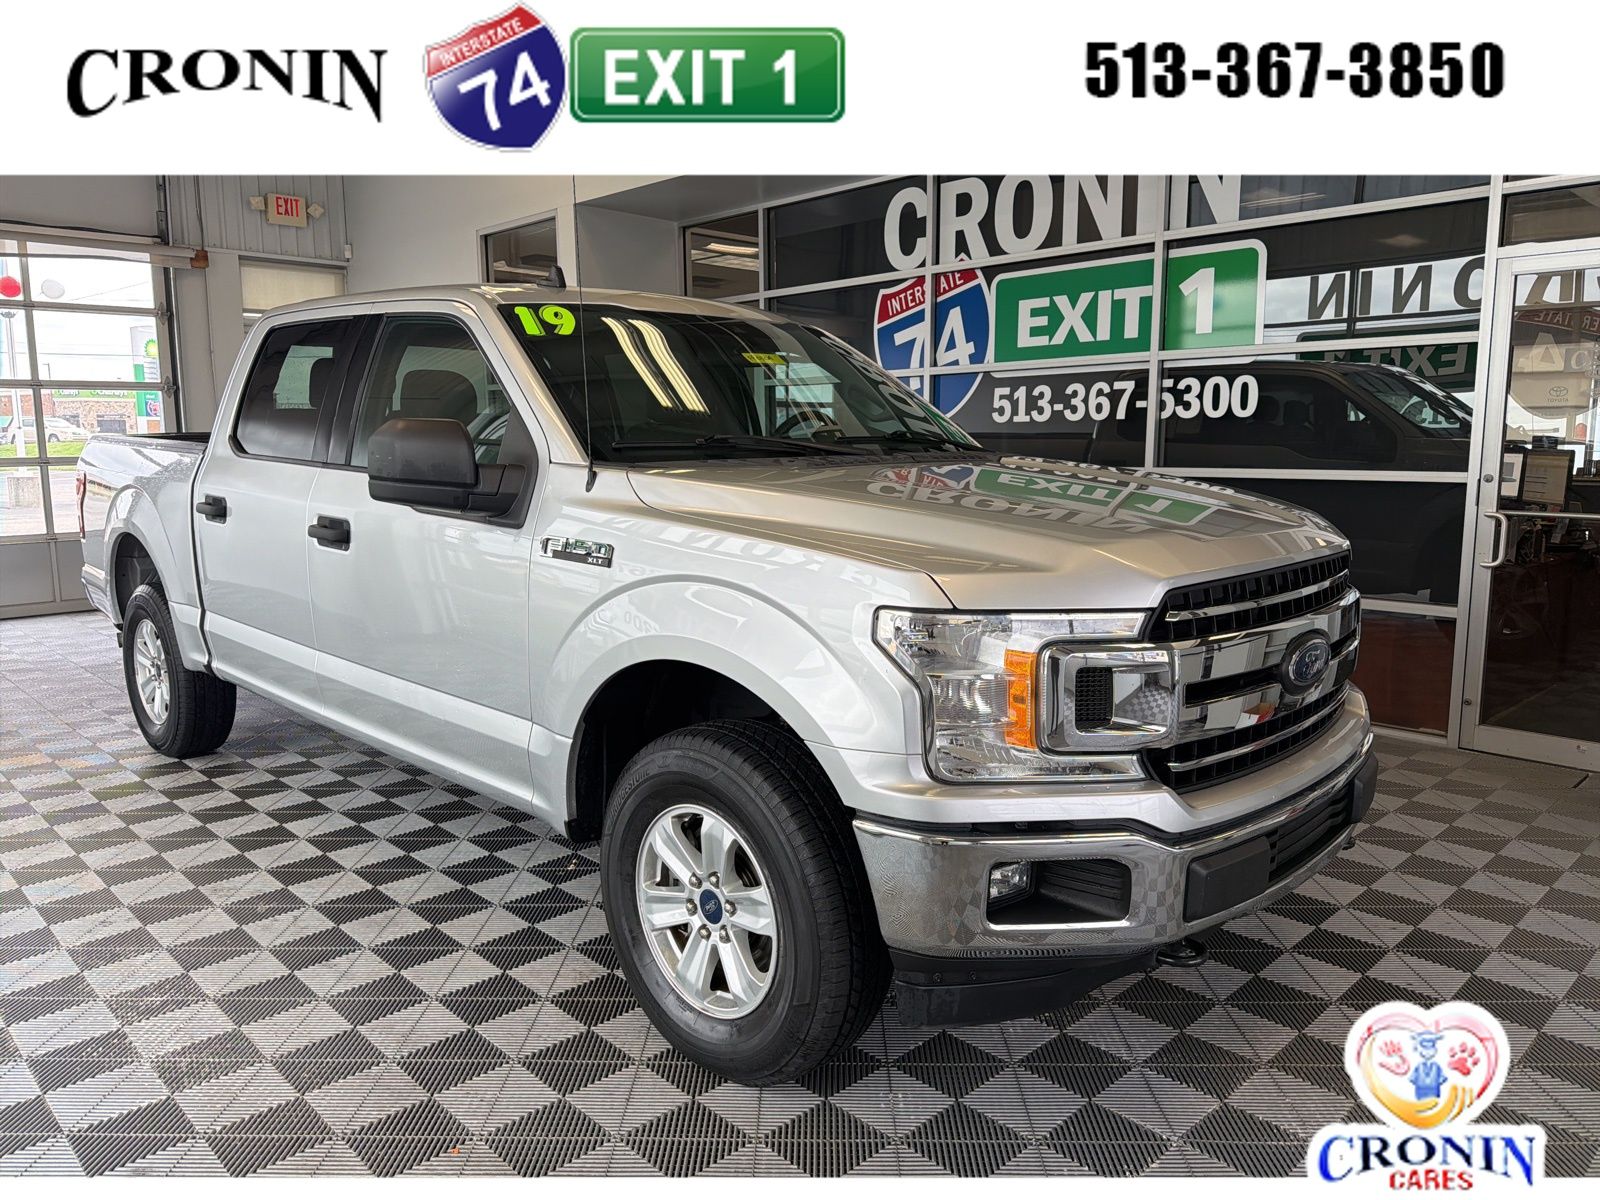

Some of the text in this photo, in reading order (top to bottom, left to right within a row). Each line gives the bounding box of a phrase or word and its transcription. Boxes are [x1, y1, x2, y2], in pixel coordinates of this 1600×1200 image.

[275, 195, 300, 218] EXIT
[884, 175, 1241, 271] CRONIN
[514, 305, 576, 337] 19
[1017, 267, 1216, 348] EXIT 1
[893, 305, 976, 391] 74
[991, 374, 1259, 423] 513-367-5300
[587, 557, 603, 565] XLT
